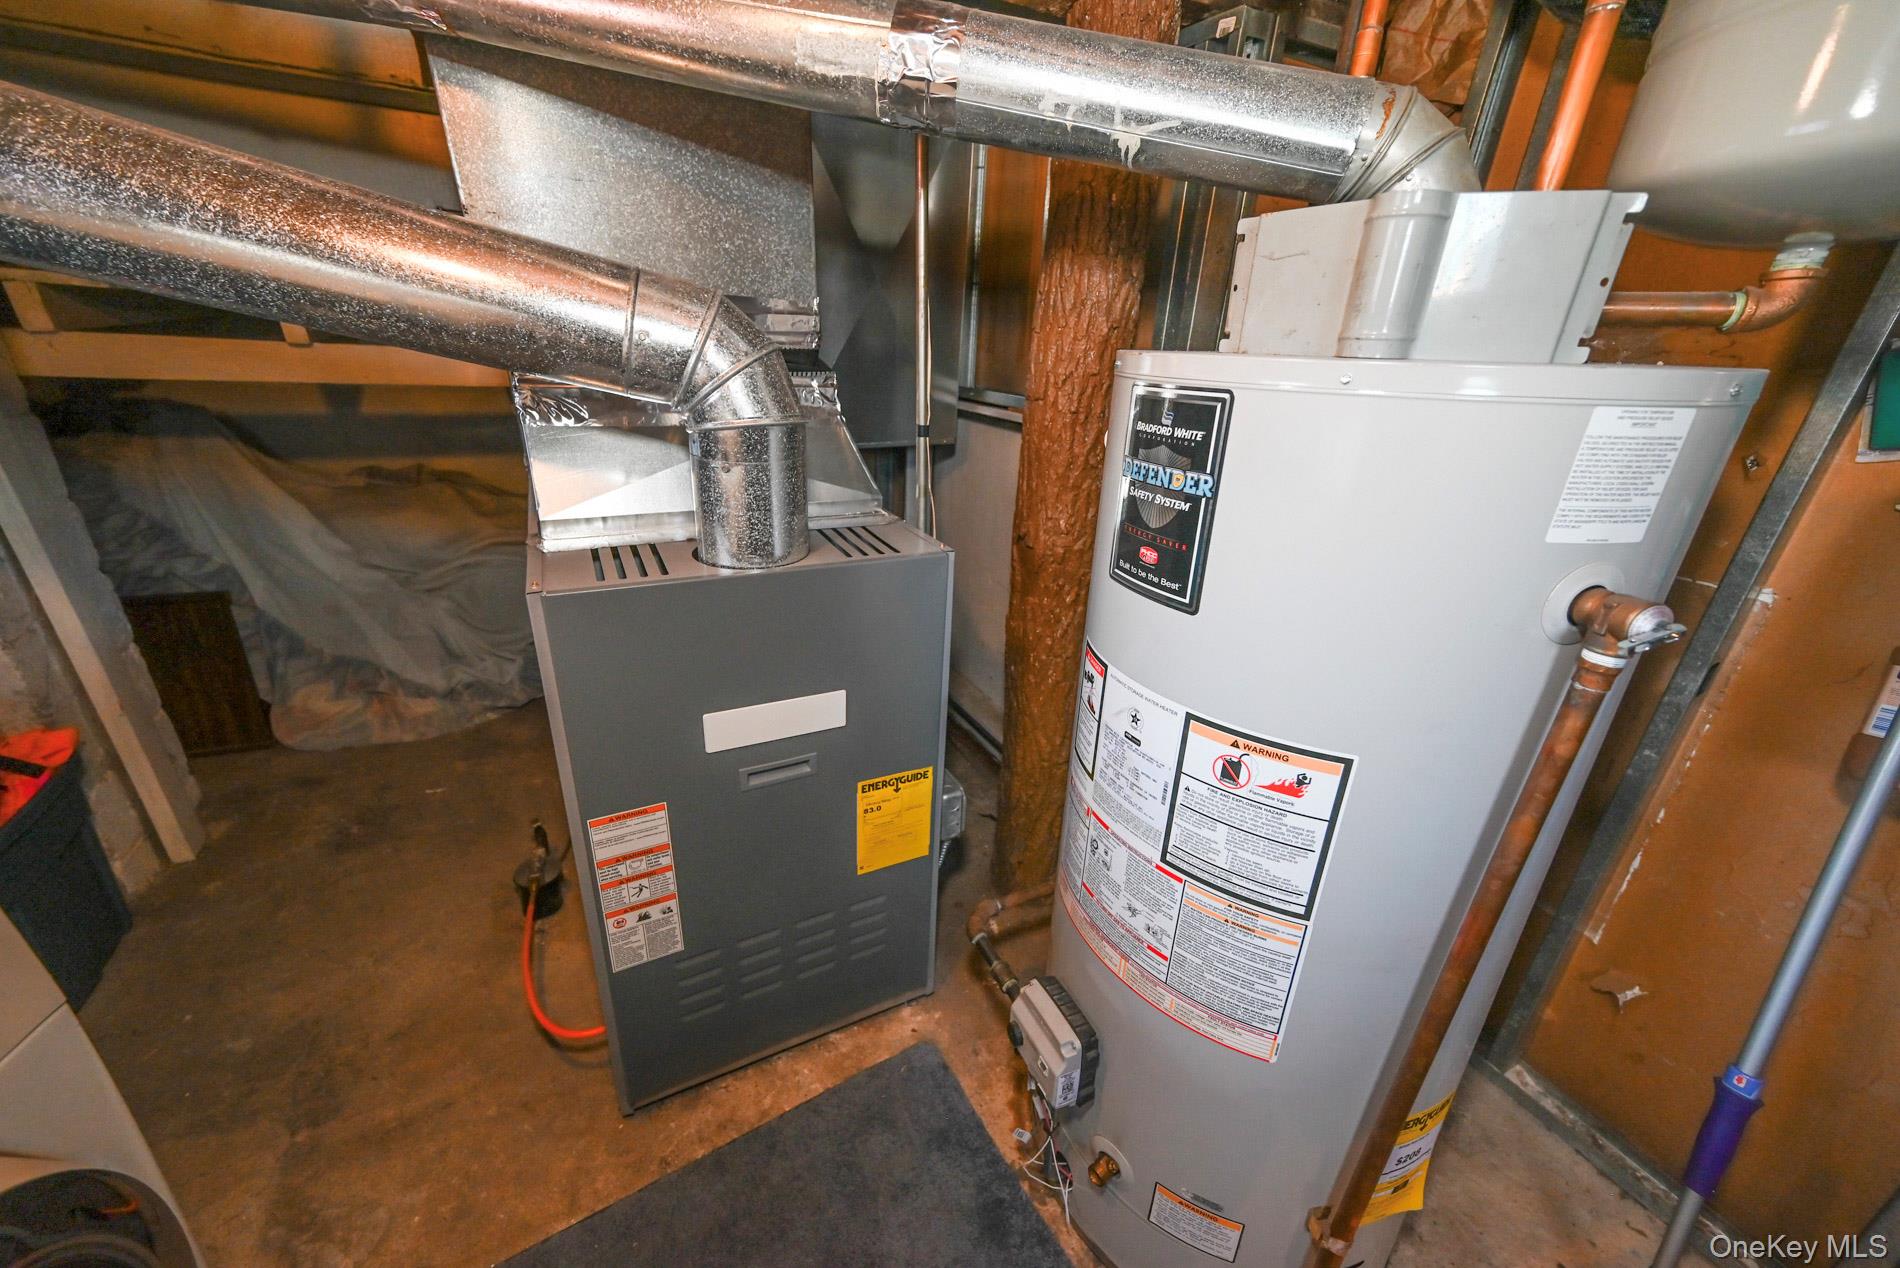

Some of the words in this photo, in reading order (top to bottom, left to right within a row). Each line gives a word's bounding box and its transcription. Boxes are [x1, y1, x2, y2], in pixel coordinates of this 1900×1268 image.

[1136, 421, 1172, 436] BRADFORD
[1174, 427, 1204, 440] WHITE
[1139, 433, 1195, 446] CORPORATION
[1123, 457, 1214, 497] DEFENDER
[1130, 486, 1154, 502] SAFETY
[1155, 494, 1190, 512] SYSTEM
[1156, 536, 1188, 552] SAVER
[1120, 560, 1130, 570] Built
[1131, 565, 1137, 574] to
[1138, 568, 1147, 577] be
[1148, 572, 1159, 583] the
[1160, 578, 1180, 590] Best
[1160, 704, 1178, 716] HEATER
[1243, 742, 1289, 762] WARNING
[861, 770, 929, 793] ENERGYGUIDE
[1249, 790, 1275, 801] Flammable
[1277, 798, 1294, 806] Vapors
[616, 809, 648, 820] WARNING
[864, 805, 882, 814] 83.0
[1232, 797, 1262, 810] EXPLOSION
[1264, 808, 1287, 818] HAZARD
[1234, 906, 1260, 918] WARNING
[1231, 921, 1256, 933] WARNING
[1183, 1202, 1218, 1222] WARNING
